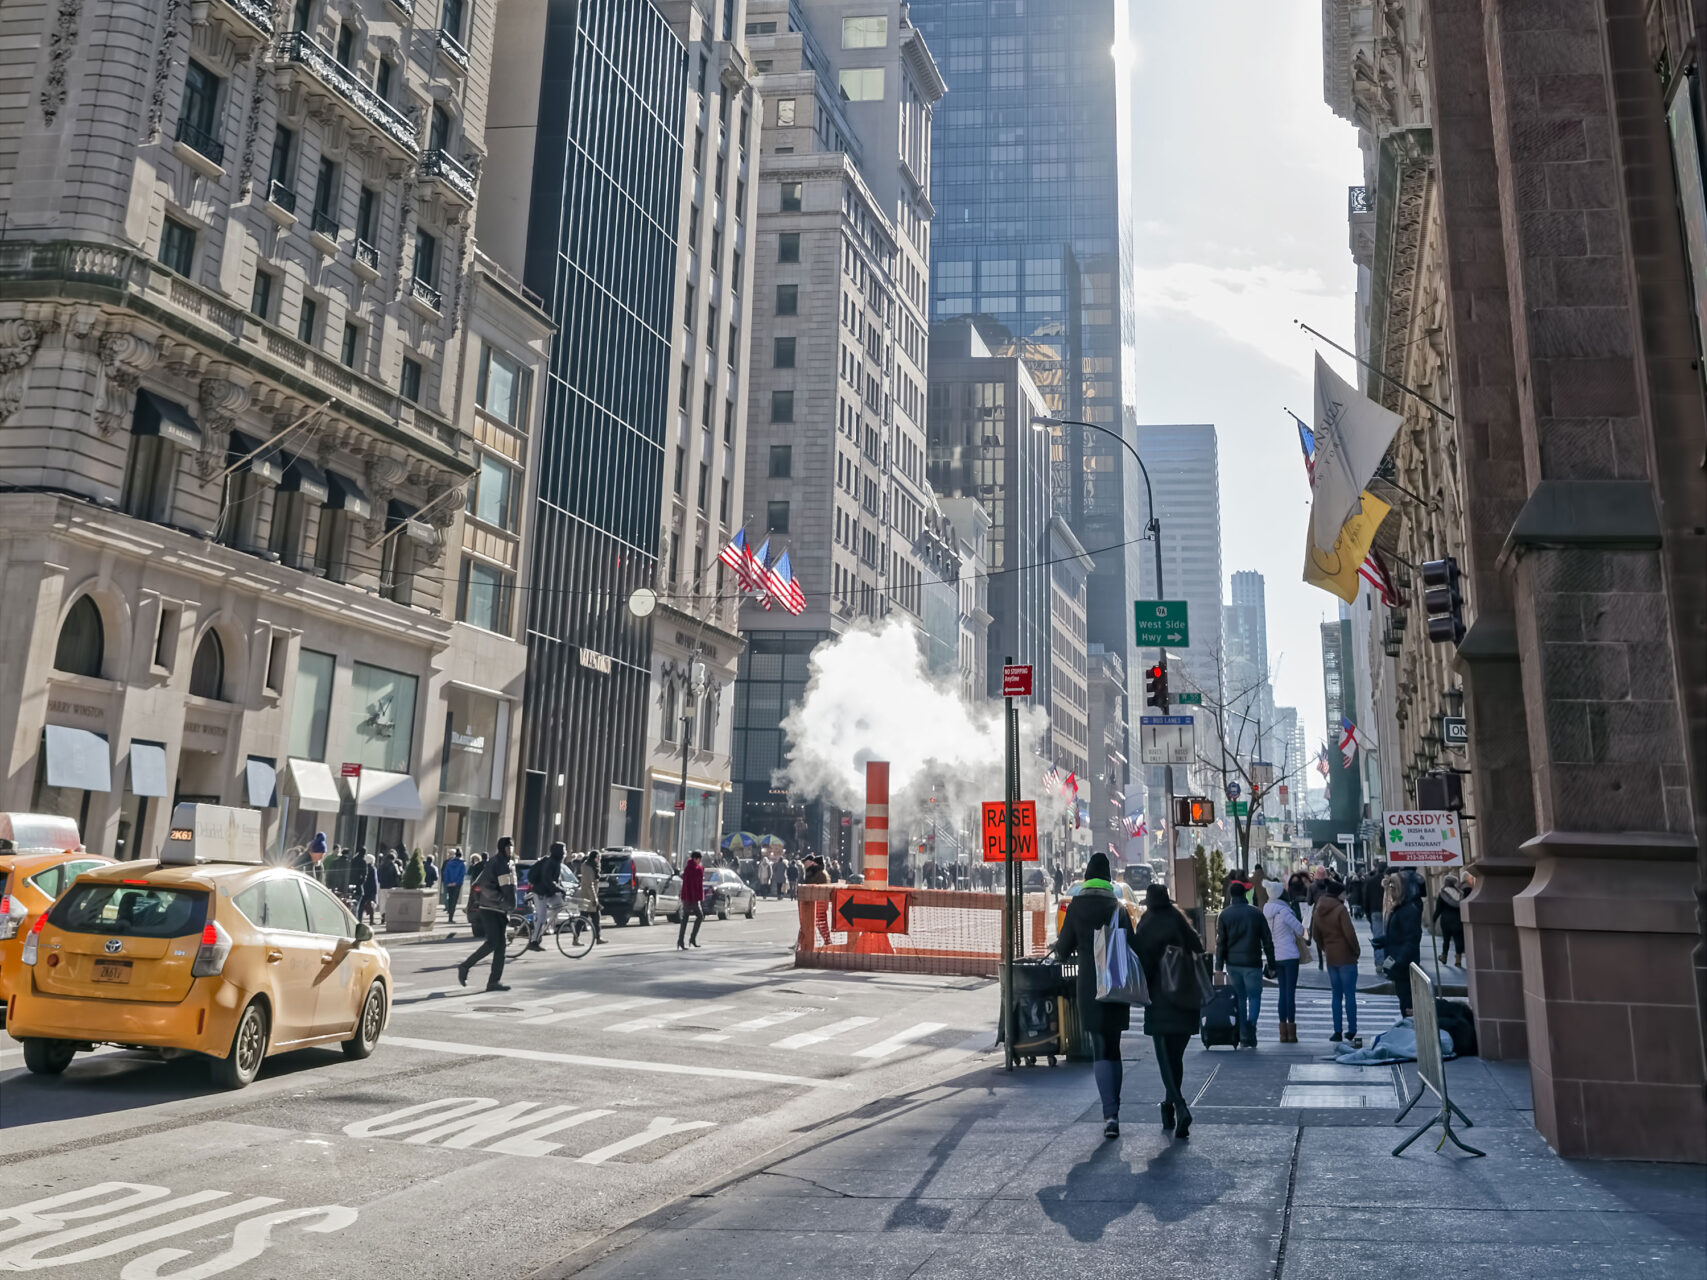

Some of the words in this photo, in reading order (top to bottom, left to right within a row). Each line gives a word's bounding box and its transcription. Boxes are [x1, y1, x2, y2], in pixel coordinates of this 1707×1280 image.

[1157, 607, 1166, 616] 9A
[1138, 621, 1162, 629] West
[1165, 620, 1185, 629] Side
[1142, 633, 1162, 643] Hwy
[987, 808, 1030, 828] RASE
[1388, 814, 1454, 826] CASSIDY'S
[342, 1096, 719, 1165] ONLY
[0, 1181, 360, 1280] BUS
